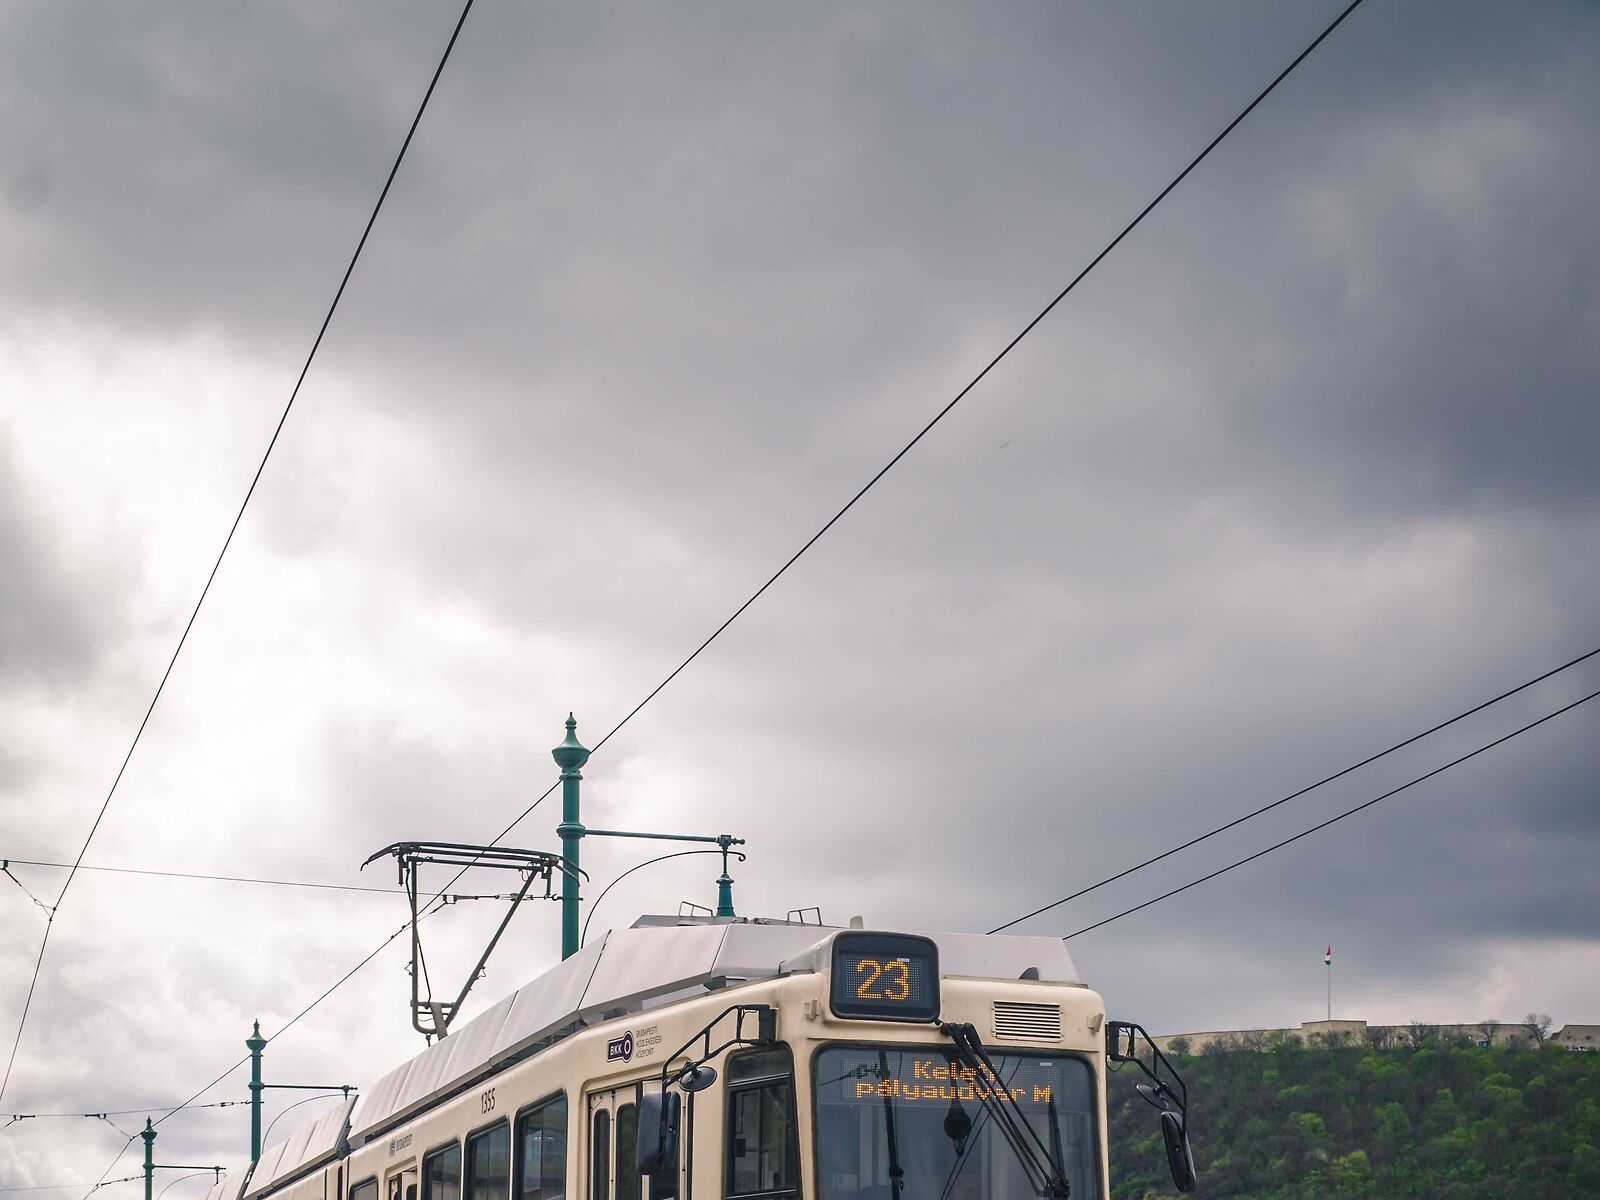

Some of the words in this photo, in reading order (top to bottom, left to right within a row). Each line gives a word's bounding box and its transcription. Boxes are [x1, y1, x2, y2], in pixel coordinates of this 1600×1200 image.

[857, 959, 909, 1000] 23
[610, 1044, 622, 1056] BKK
[481, 1088, 496, 1115] 1355
[1034, 1083, 1051, 1103] M
